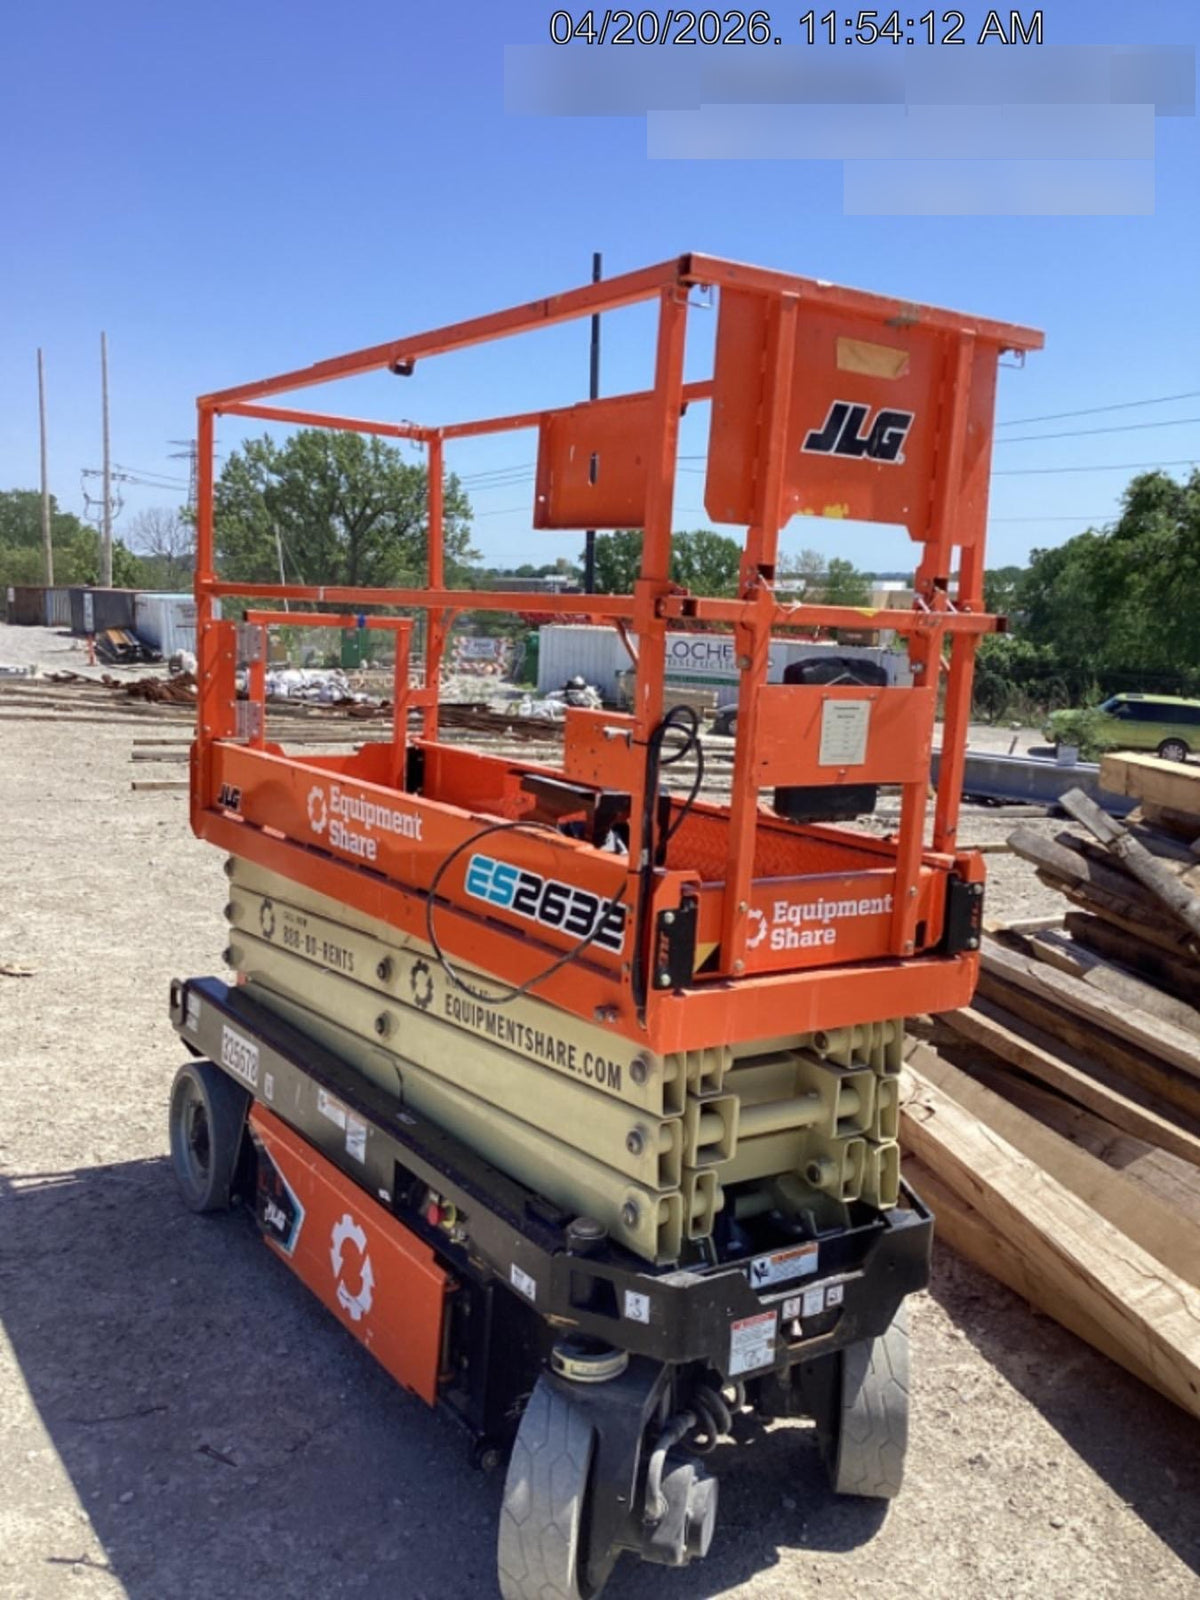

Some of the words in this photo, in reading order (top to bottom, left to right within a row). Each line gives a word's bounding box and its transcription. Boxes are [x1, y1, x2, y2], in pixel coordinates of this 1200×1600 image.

[801, 400, 915, 464] JLG
[217, 782, 242, 811] JLG
[329, 785, 422, 841] Equipment
[329, 819, 377, 861] Share
[465, 853, 629, 955] ES2632
[772, 894, 892, 926] Equipment
[770, 928, 837, 950] Share
[445, 993, 622, 1091] EQUIPMENTSHARE.COM
